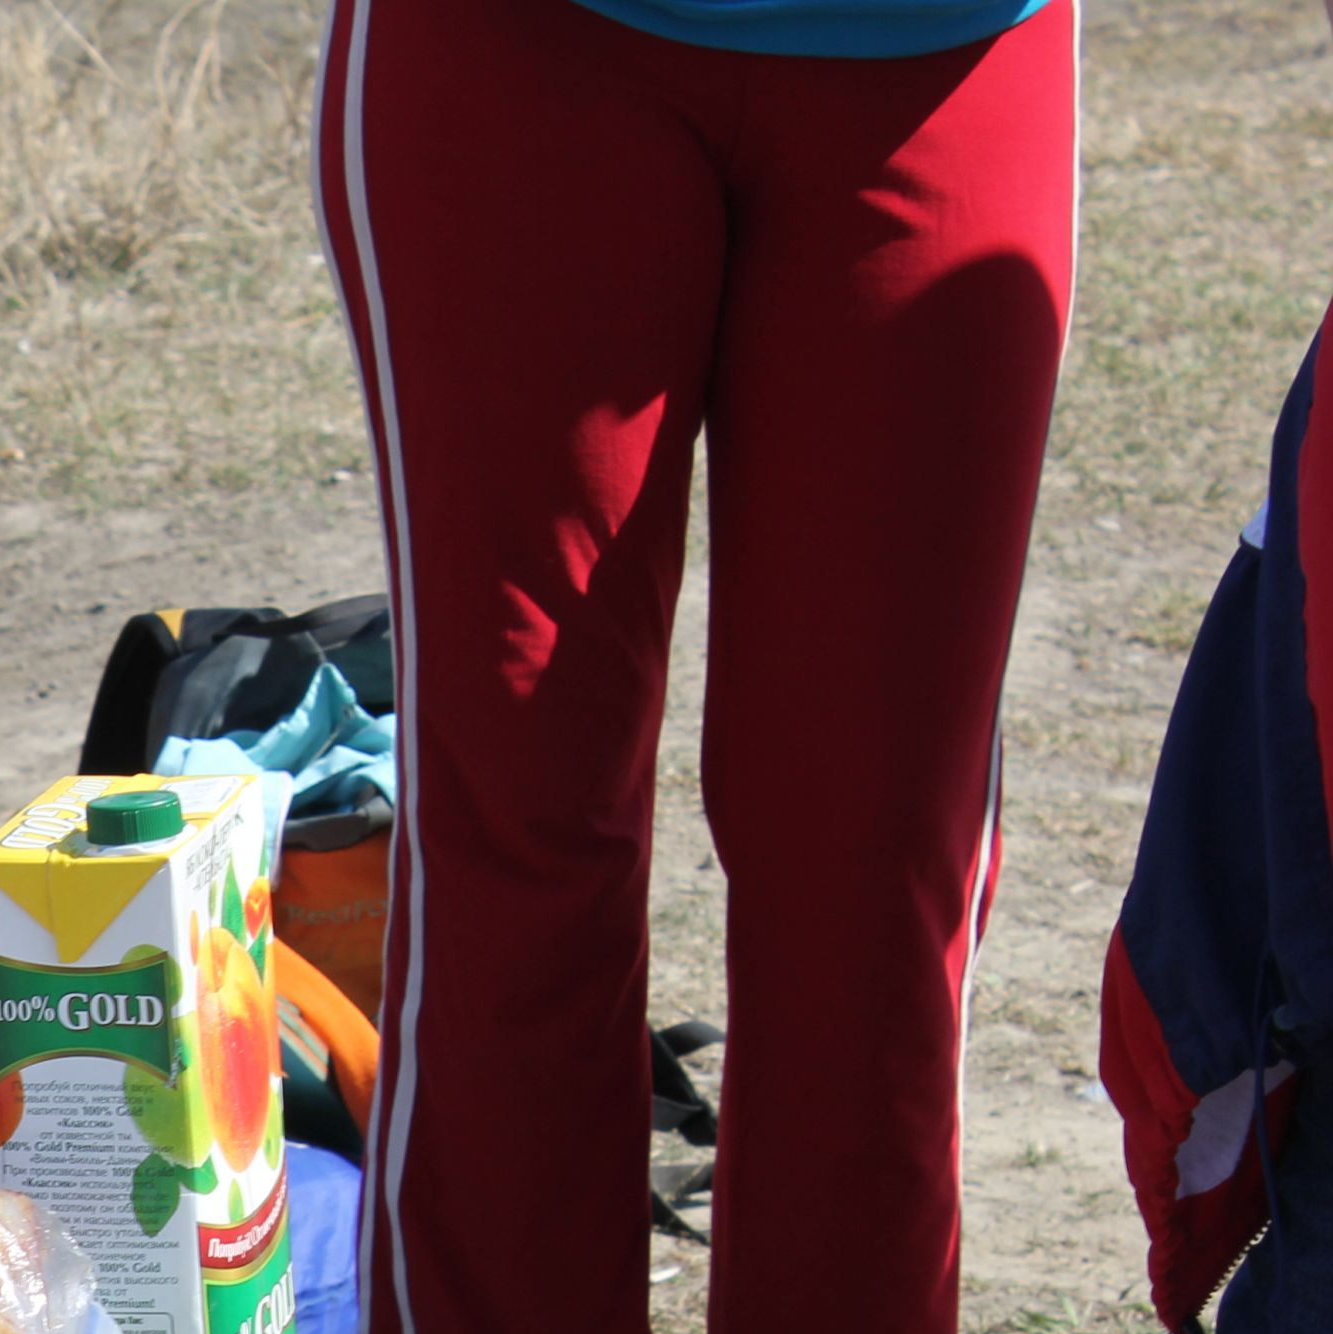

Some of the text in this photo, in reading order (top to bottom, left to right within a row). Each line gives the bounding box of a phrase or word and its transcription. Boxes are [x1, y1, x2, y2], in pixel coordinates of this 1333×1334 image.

[56, 992, 165, 1030] GOLD
[13, 1081, 71, 1097] Попробуй
[73, 1081, 124, 1093] отличный
[26, 1105, 144, 1117] напитков 100% Gold
[2, 1142, 31, 1152] 100%
[34, 1141, 63, 1152] Gold
[65, 1141, 116, 1152] Premium
[2, 1165, 28, 1178] При
[29, 1167, 108, 1178] производстве
[69, 1226, 112, 1238] Быстро
[99, 1261, 162, 1273] 100% Gold
